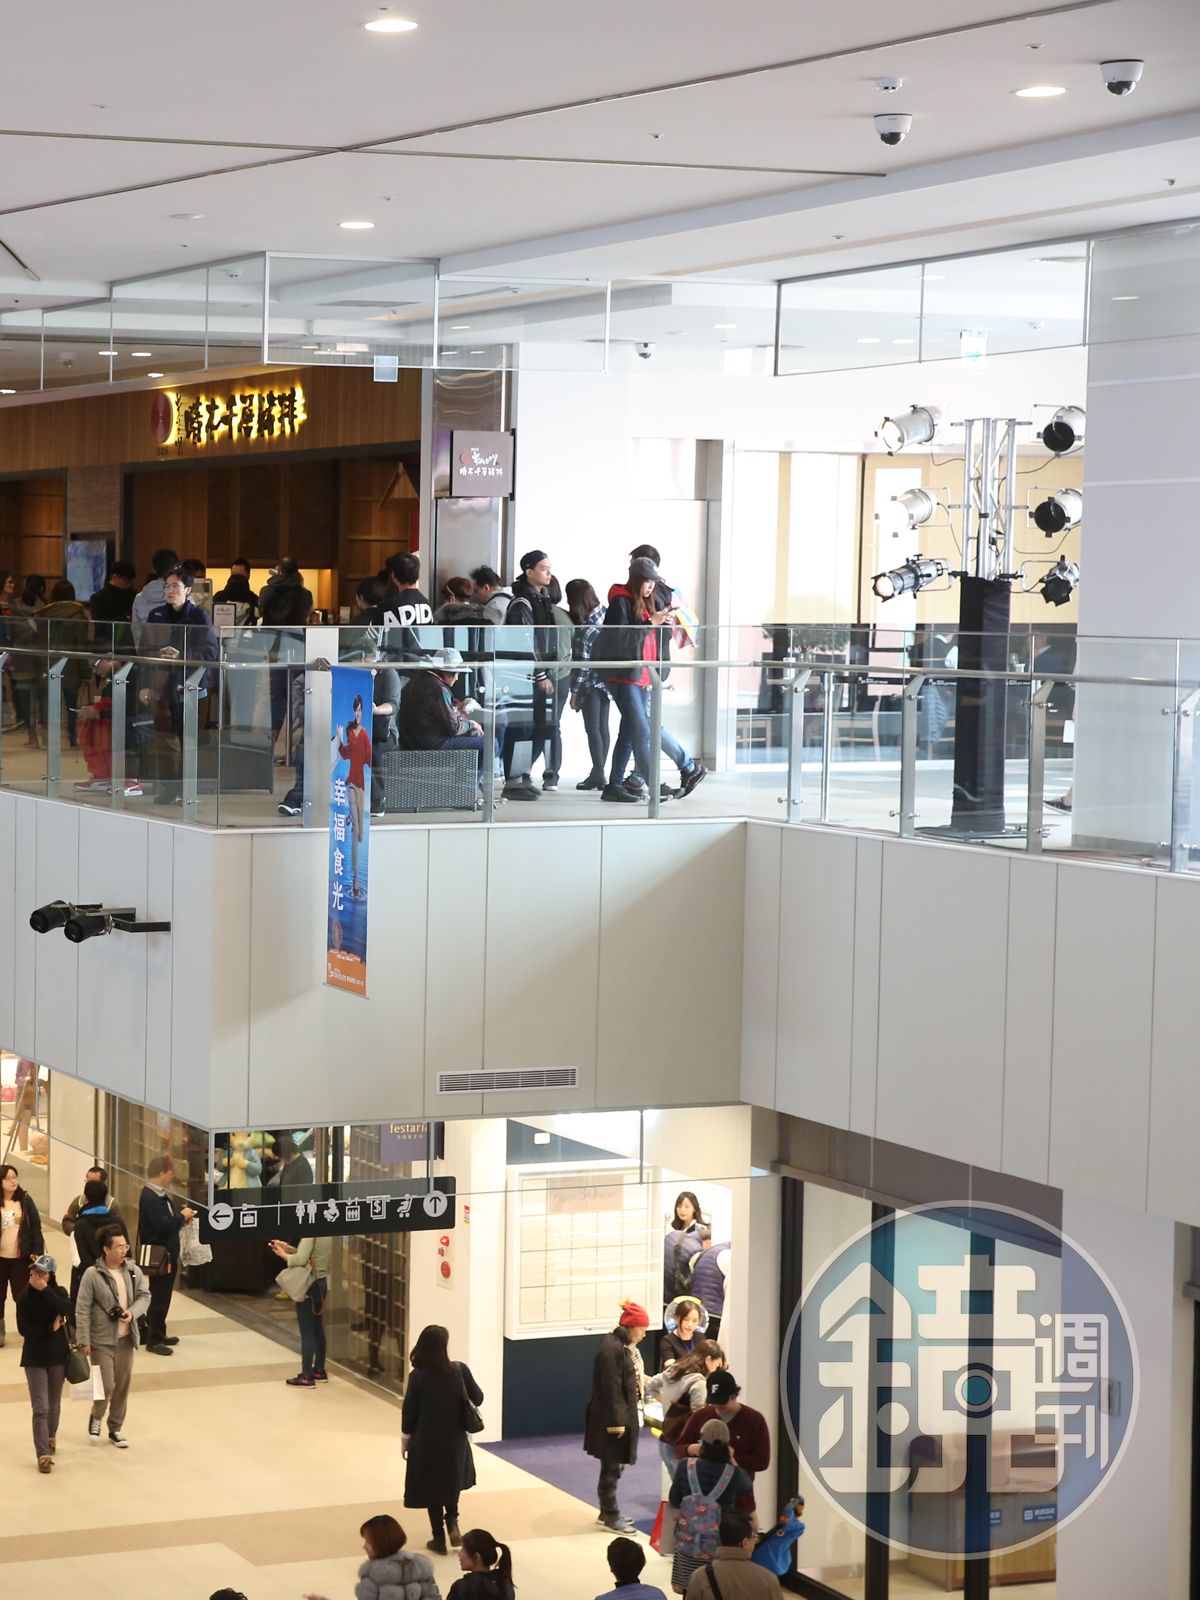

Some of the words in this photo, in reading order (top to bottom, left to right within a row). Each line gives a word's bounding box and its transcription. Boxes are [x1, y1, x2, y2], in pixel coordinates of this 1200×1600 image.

[383, 603, 434, 632] ADID
[332, 777, 347, 911] 幸福食光
